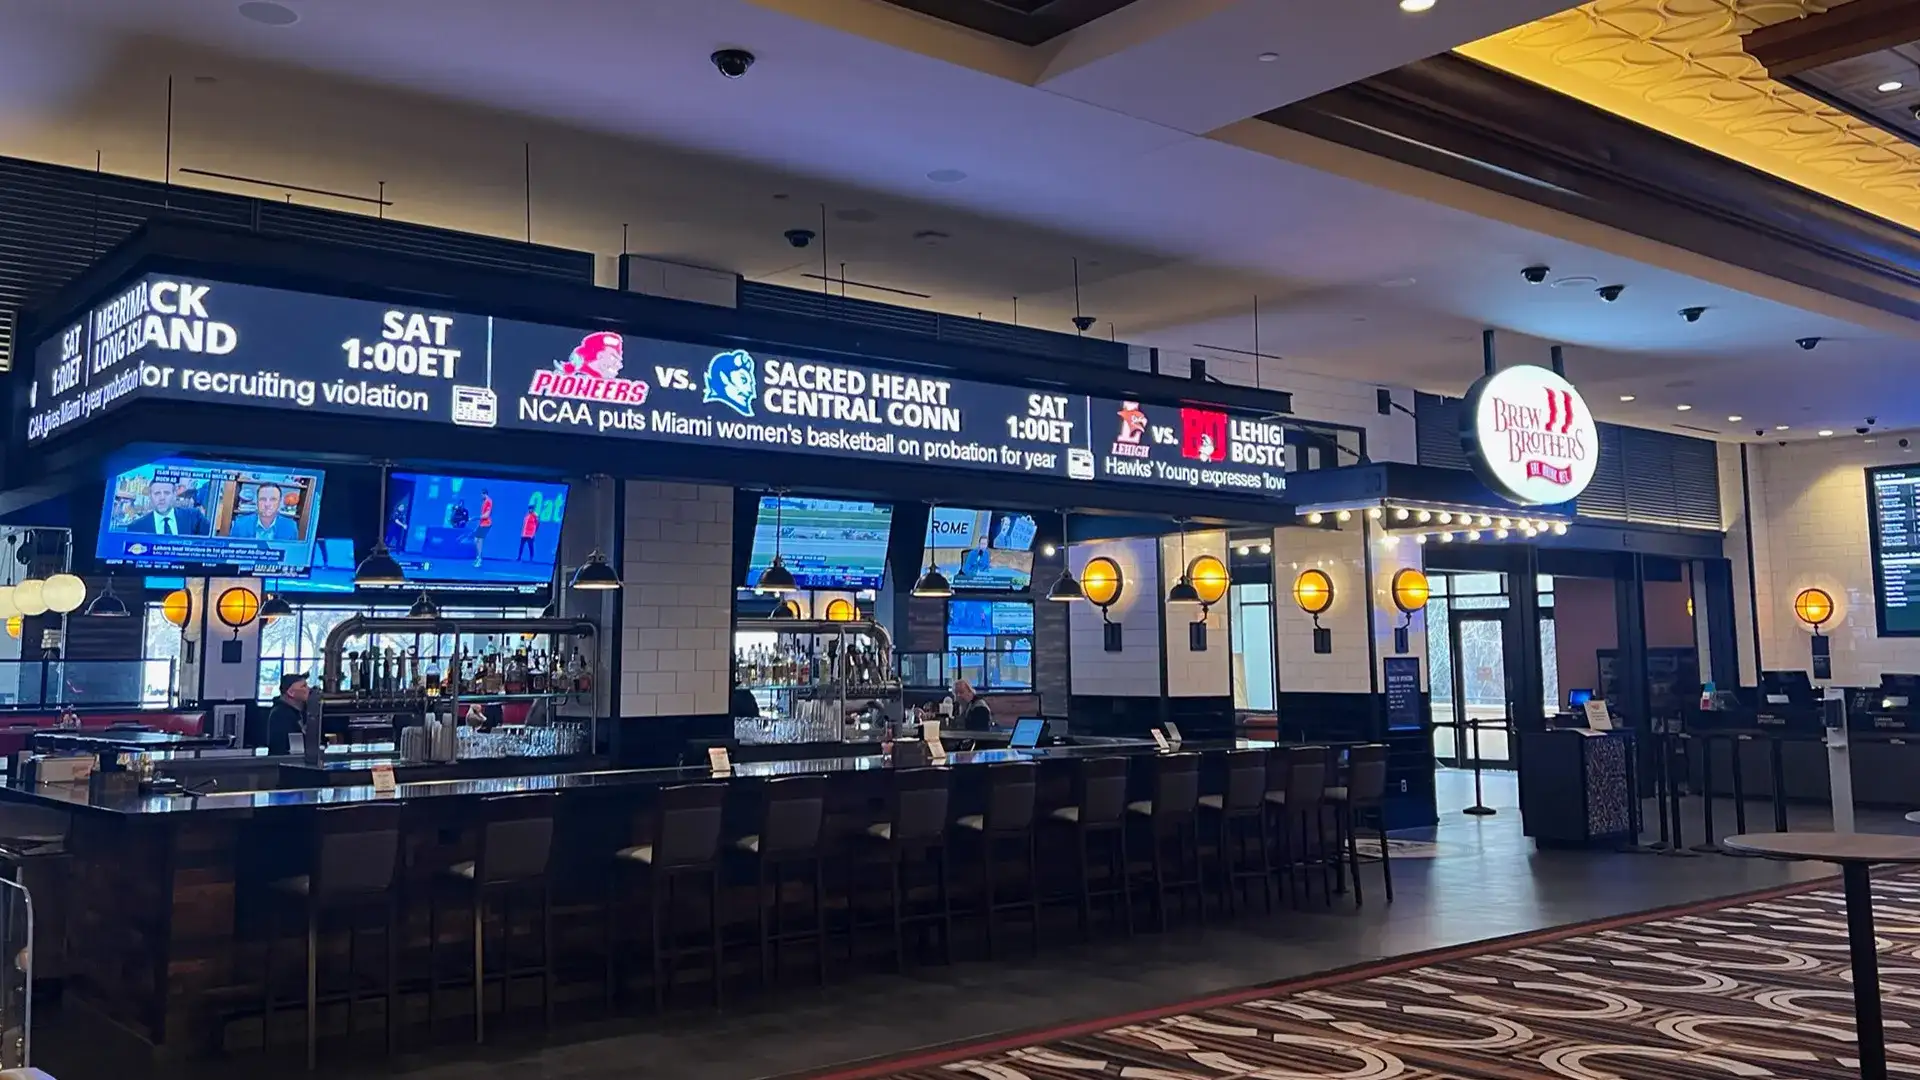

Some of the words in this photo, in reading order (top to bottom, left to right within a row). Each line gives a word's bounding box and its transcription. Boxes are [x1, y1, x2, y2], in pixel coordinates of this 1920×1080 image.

[62, 324, 82, 361] SAT
[382, 310, 453, 346] SAT
[93, 328, 126, 374] LONG
[342, 338, 461, 379] 1:00ET
[52, 354, 82, 397] 1:00ET
[529, 371, 649, 405] PIONEERS
[763, 359, 866, 395] SACRED
[871, 373, 950, 406] HEART
[42, 409, 60, 439] gives
[60, 394, 81, 425] Miami
[81, 391, 103, 418] 1-year
[102, 368, 140, 410] probation
[182, 369, 315, 406] recruiting
[322, 379, 429, 411] violation
[763, 388, 883, 424] CENTRAL
[887, 402, 960, 432] CONN
[1028, 394, 1068, 419] SAT
[519, 397, 594, 427] NCAA
[599, 409, 645, 432] puts
[651, 410, 712, 438] Miami
[716, 423, 802, 446] women's
[807, 425, 894, 454] basketball
[898, 438, 920, 456] on
[924, 440, 998, 463] probation
[1001, 445, 1023, 466] for
[1025, 452, 1058, 471] year
[1006, 415, 1074, 444] 1:00ET
[1111, 442, 1150, 457] LEHIGH
[1105, 456, 1154, 478] Hawks'
[1156, 460, 1199, 485] Young
[1201, 469, 1261, 488] expresses
[932, 520, 969, 535] ROME
